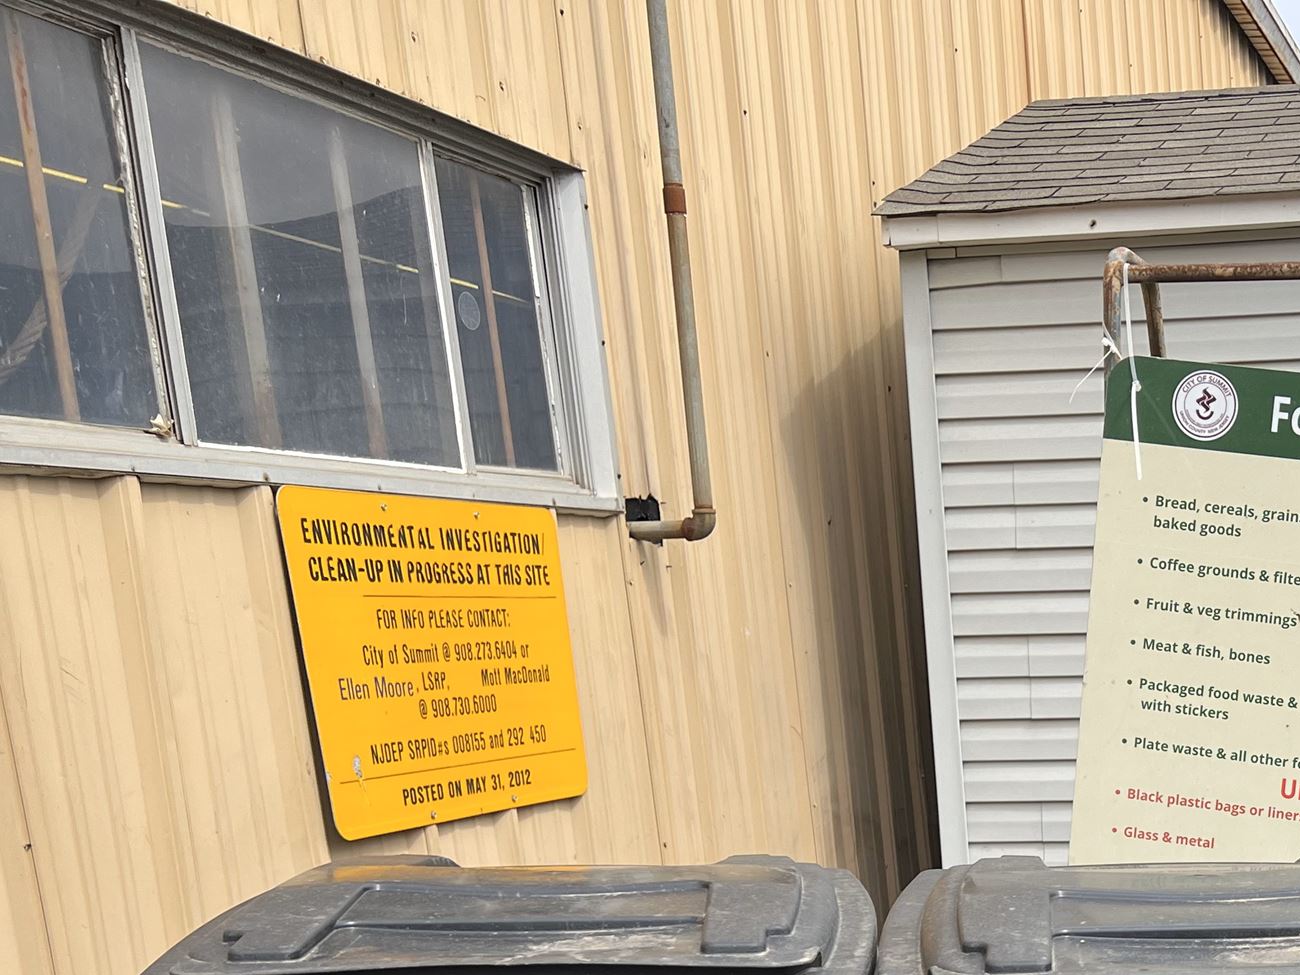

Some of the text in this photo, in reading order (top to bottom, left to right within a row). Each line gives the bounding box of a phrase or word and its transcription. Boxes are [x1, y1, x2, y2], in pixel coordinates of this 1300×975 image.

[1182, 378, 1196, 393] CITY
[1209, 376, 1232, 397] SUMMIT
[1155, 495, 1200, 513] Bread,
[1204, 502, 1258, 520] cereals,
[301, 517, 435, 550] ENVIRONMENTAL
[1153, 516, 1242, 538] baked goods
[308, 556, 550, 586] CLEAN-UP IN PROGRESS AT THIS SITE
[1149, 557, 1194, 573] Coffee
[1198, 562, 1255, 581] grounds
[1259, 569, 1270, 581] &
[376, 608, 511, 629] FOR INFO PLEASE CONTACT:
[1146, 597, 1297, 628] Fruit & veg trimmings
[362, 640, 529, 668] City of Summit @ 908.273.6404 or
[1142, 638, 1271, 665] Meat & fish, bones
[338, 677, 370, 701] Ellen
[481, 668, 502, 686] Mott
[504, 664, 551, 685] MacDonald
[1139, 678, 1205, 698] Packaged
[1208, 685, 1239, 701] food
[1242, 691, 1285, 707] waste
[1287, 697, 1298, 709] &
[419, 694, 498, 720] @ 908.730.6000
[1141, 698, 1229, 720] with stickers
[370, 724, 547, 765] NJDEP SRPID#s 008155 and 292 450
[1134, 737, 1168, 752] Plate
[1172, 742, 1213, 758] waste
[1216, 748, 1227, 760] &
[1230, 748, 1247, 762] all
[1250, 751, 1289, 768] other
[402, 768, 532, 807] POSTED ON MAY 31, 2012
[1127, 788, 1163, 804] Black
[1167, 792, 1211, 810] plastic
[1214, 799, 1245, 817] bags
[1249, 805, 1264, 817] or
[1123, 825, 1215, 849] Glass & metal
